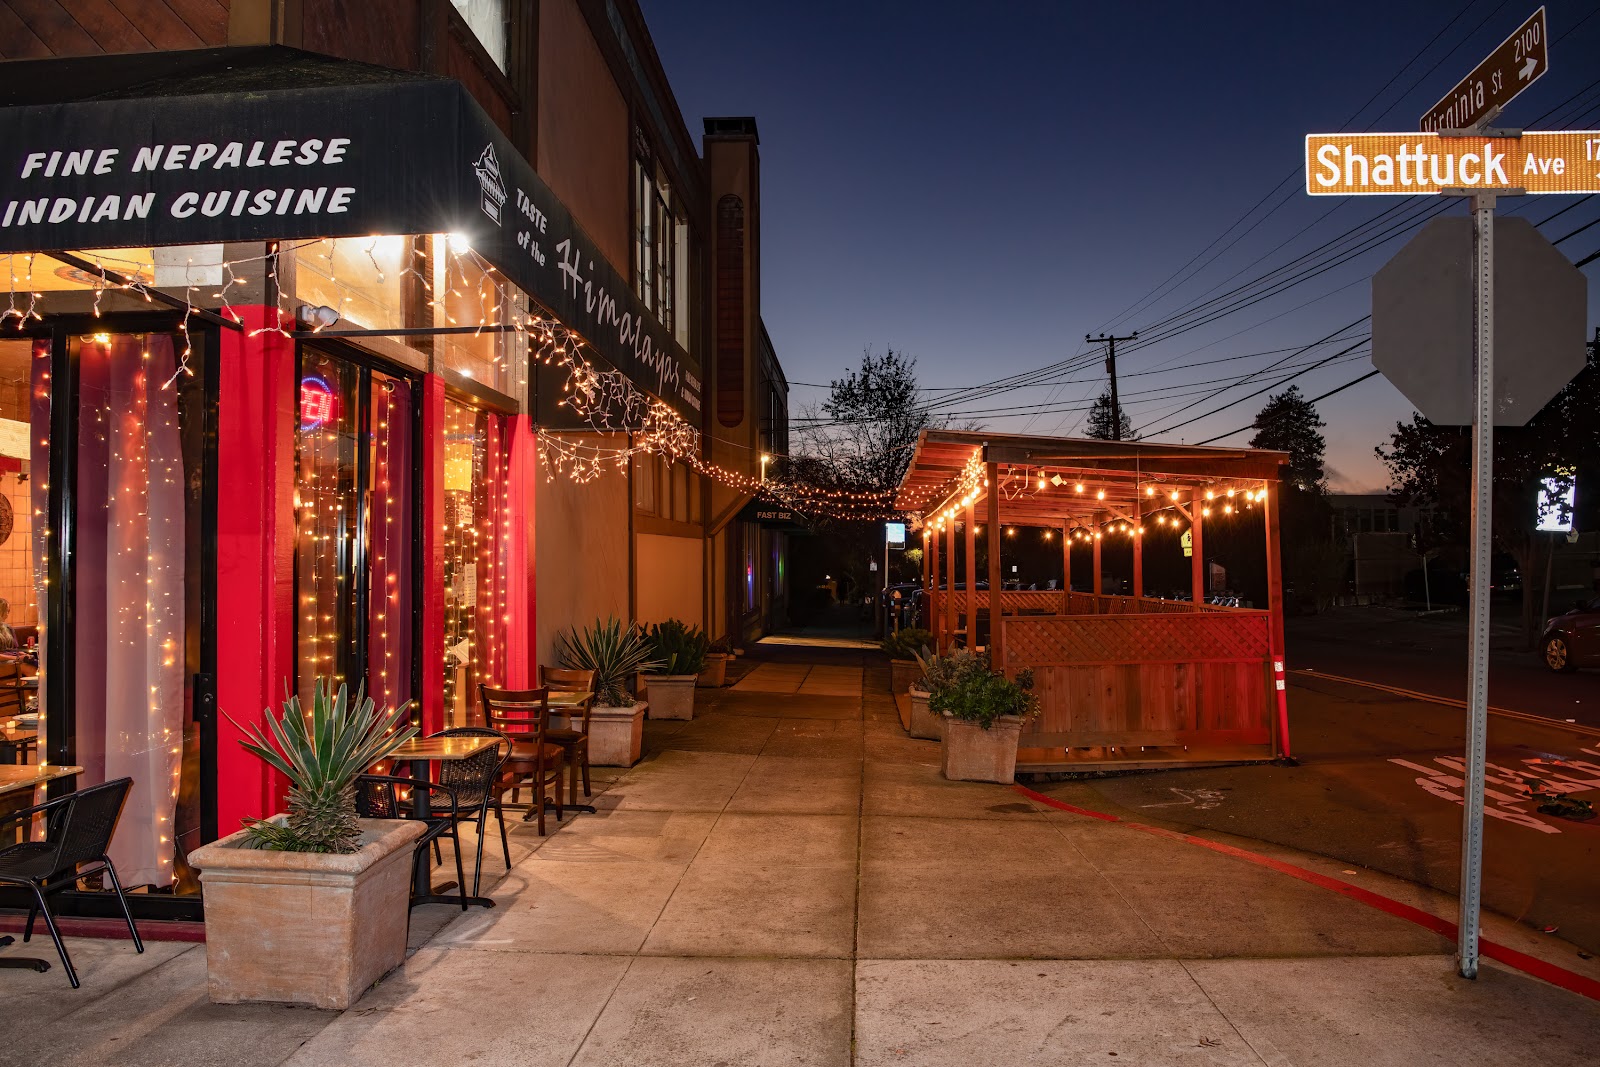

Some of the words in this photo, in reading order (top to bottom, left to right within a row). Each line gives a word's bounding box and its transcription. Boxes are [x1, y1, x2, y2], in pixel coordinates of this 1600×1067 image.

[1514, 21, 1540, 63] 2100
[1491, 68, 1503, 95] St
[20, 148, 119, 179] FINE
[131, 138, 351, 173] NEPALESE
[1315, 142, 1509, 187] Shattuck
[1523, 152, 1565, 175] Ave
[2, 192, 156, 227] INDIAN
[170, 187, 356, 219] CUISINE
[516, 187, 548, 235] TASTE
[516, 231, 530, 248] of
[531, 240, 546, 267] the
[555, 237, 680, 397] Himalayas
[757, 511, 777, 519] FAST
